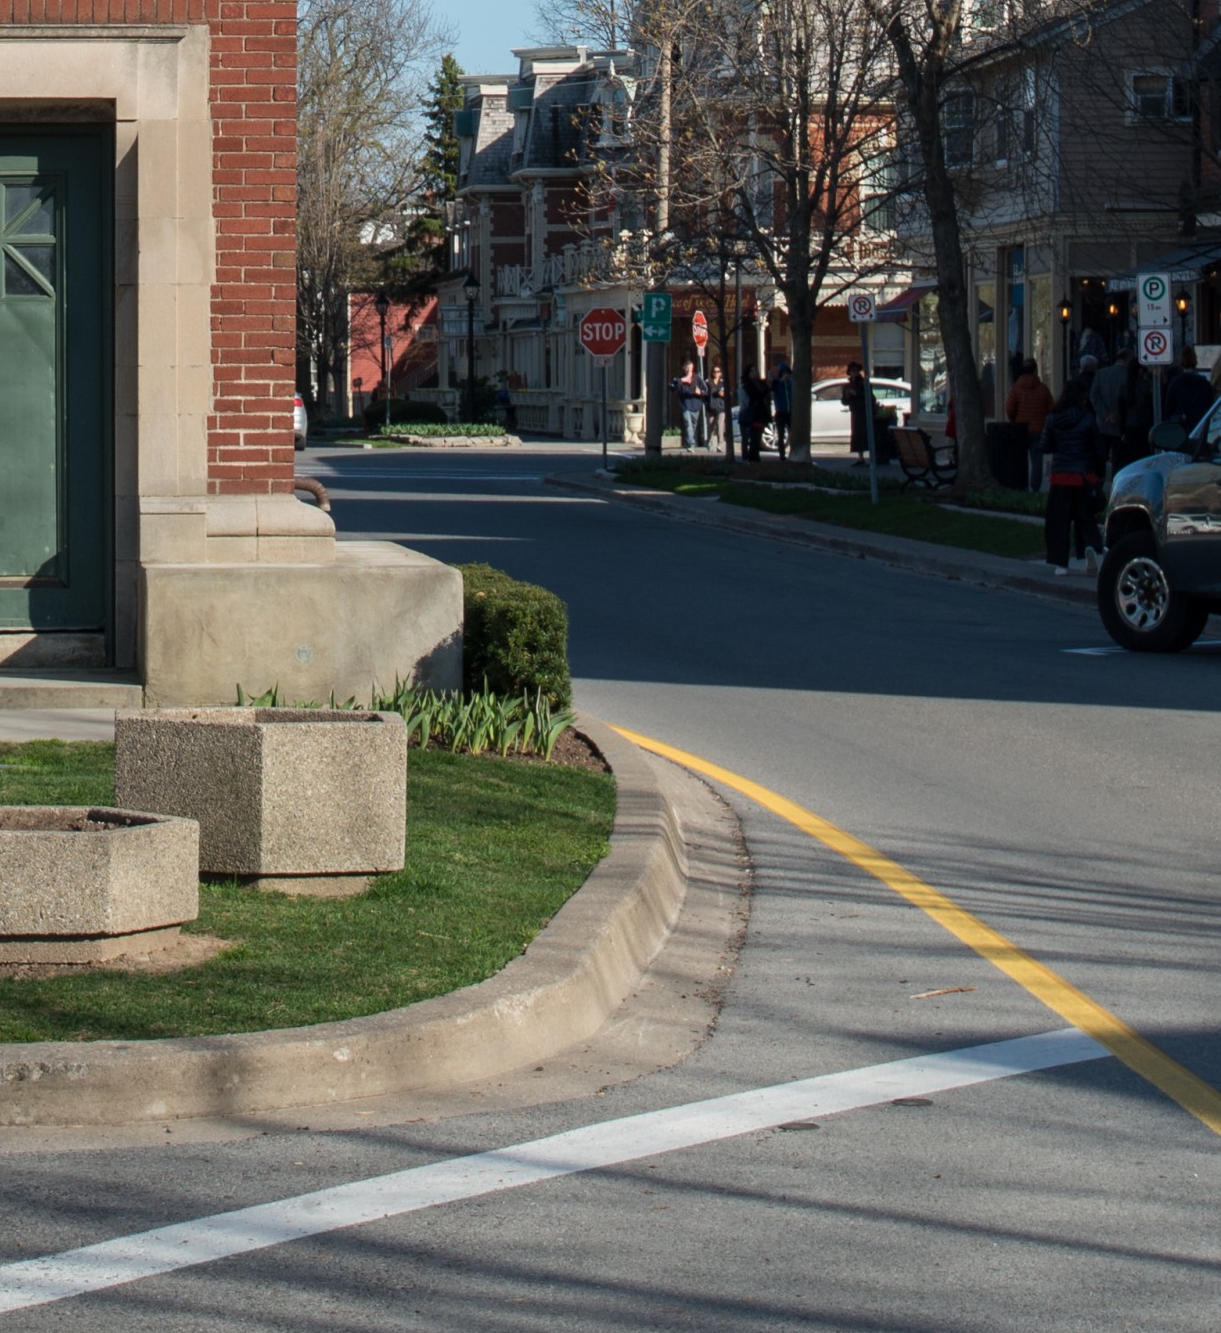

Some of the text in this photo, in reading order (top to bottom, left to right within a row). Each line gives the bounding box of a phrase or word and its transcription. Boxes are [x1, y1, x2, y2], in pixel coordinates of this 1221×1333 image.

[1149, 282, 1159, 295] P
[651, 297, 666, 318] P
[582, 322, 625, 341] STOP
